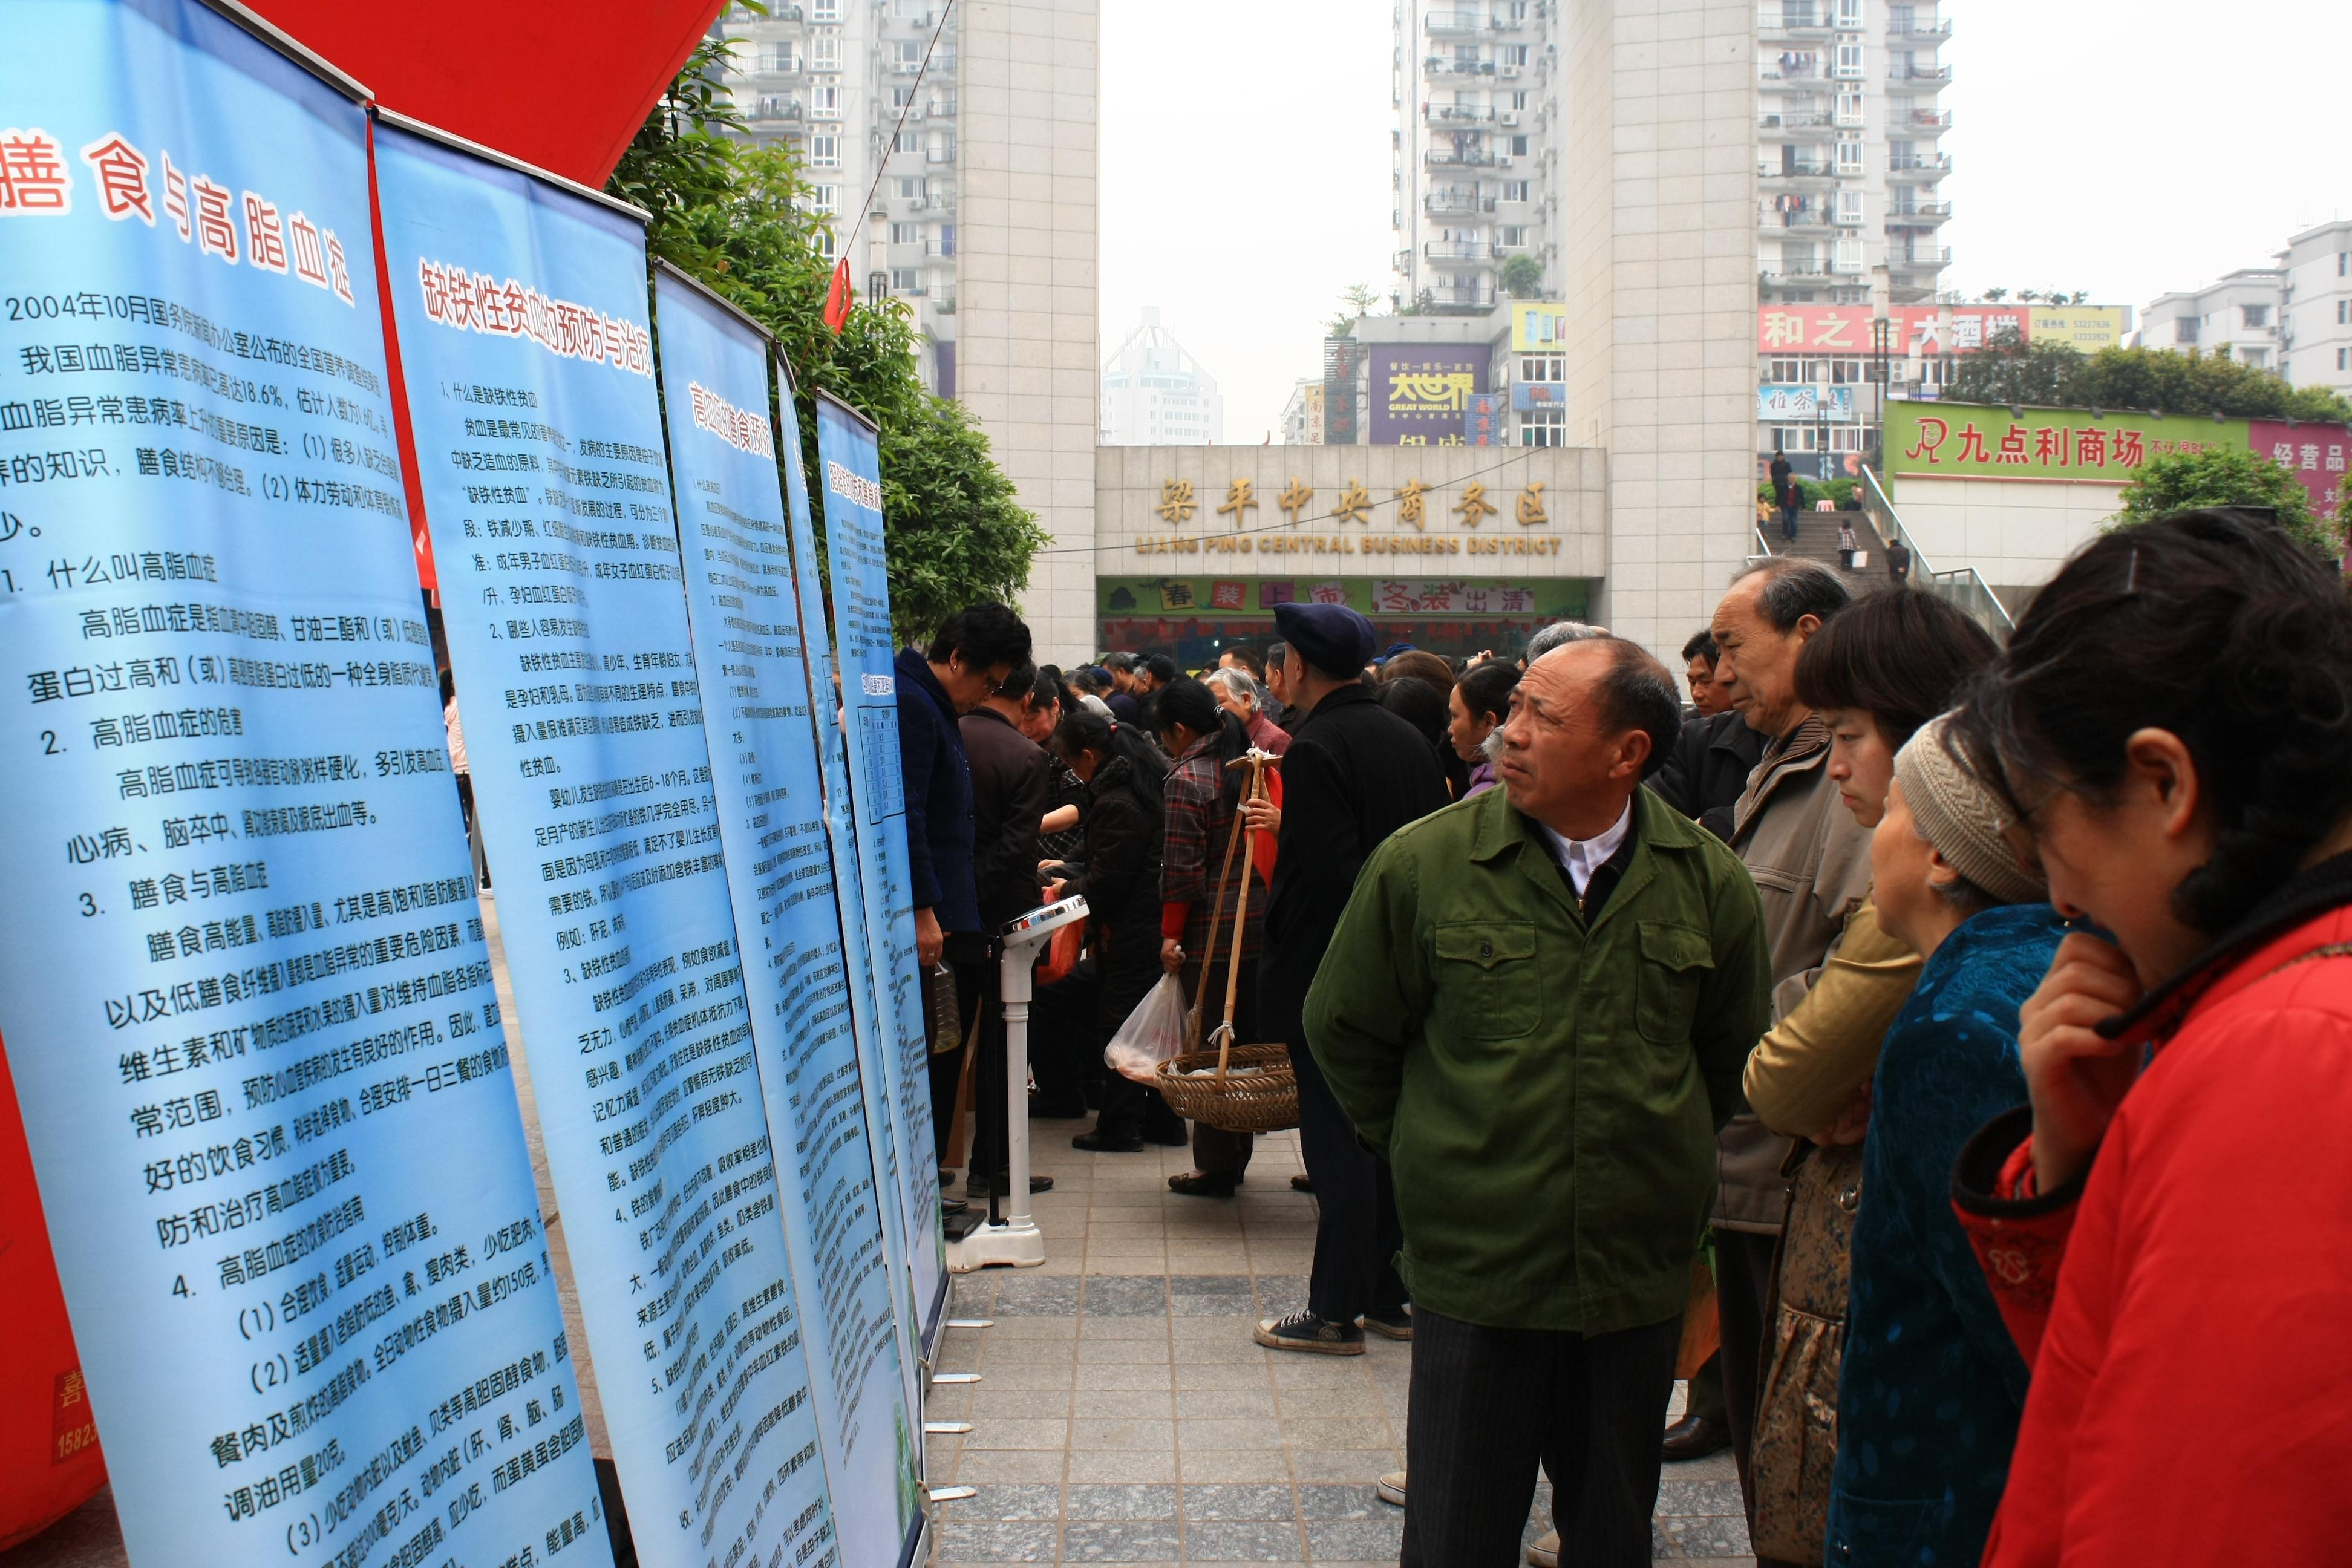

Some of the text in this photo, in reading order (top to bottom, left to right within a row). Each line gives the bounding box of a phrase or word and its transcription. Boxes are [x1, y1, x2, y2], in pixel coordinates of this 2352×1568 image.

[0, 134, 353, 304] 膳食与高脂血症
[420, 260, 652, 377] 缺铁性贫血的预防与治疗
[1389, 373, 1474, 411] 大世界
[1956, 422, 2145, 469] 九点利商场
[1154, 476, 1549, 532] 梁平中央商务区
[1135, 535, 1561, 555] LIANG PING CENTRAL BUSINESS DISTRICT
[47, 551, 218, 590] 什么叫高脂血症
[1166, 584, 1338, 606] 春装上市
[1382, 583, 1524, 613] 冬装出清
[90, 707, 244, 750] 高脂血症的危害
[519, 755, 561, 779] 性贫血。
[129, 860, 269, 910] 膳食与高脂血症
[57, 1423, 99, 1457] 15823
